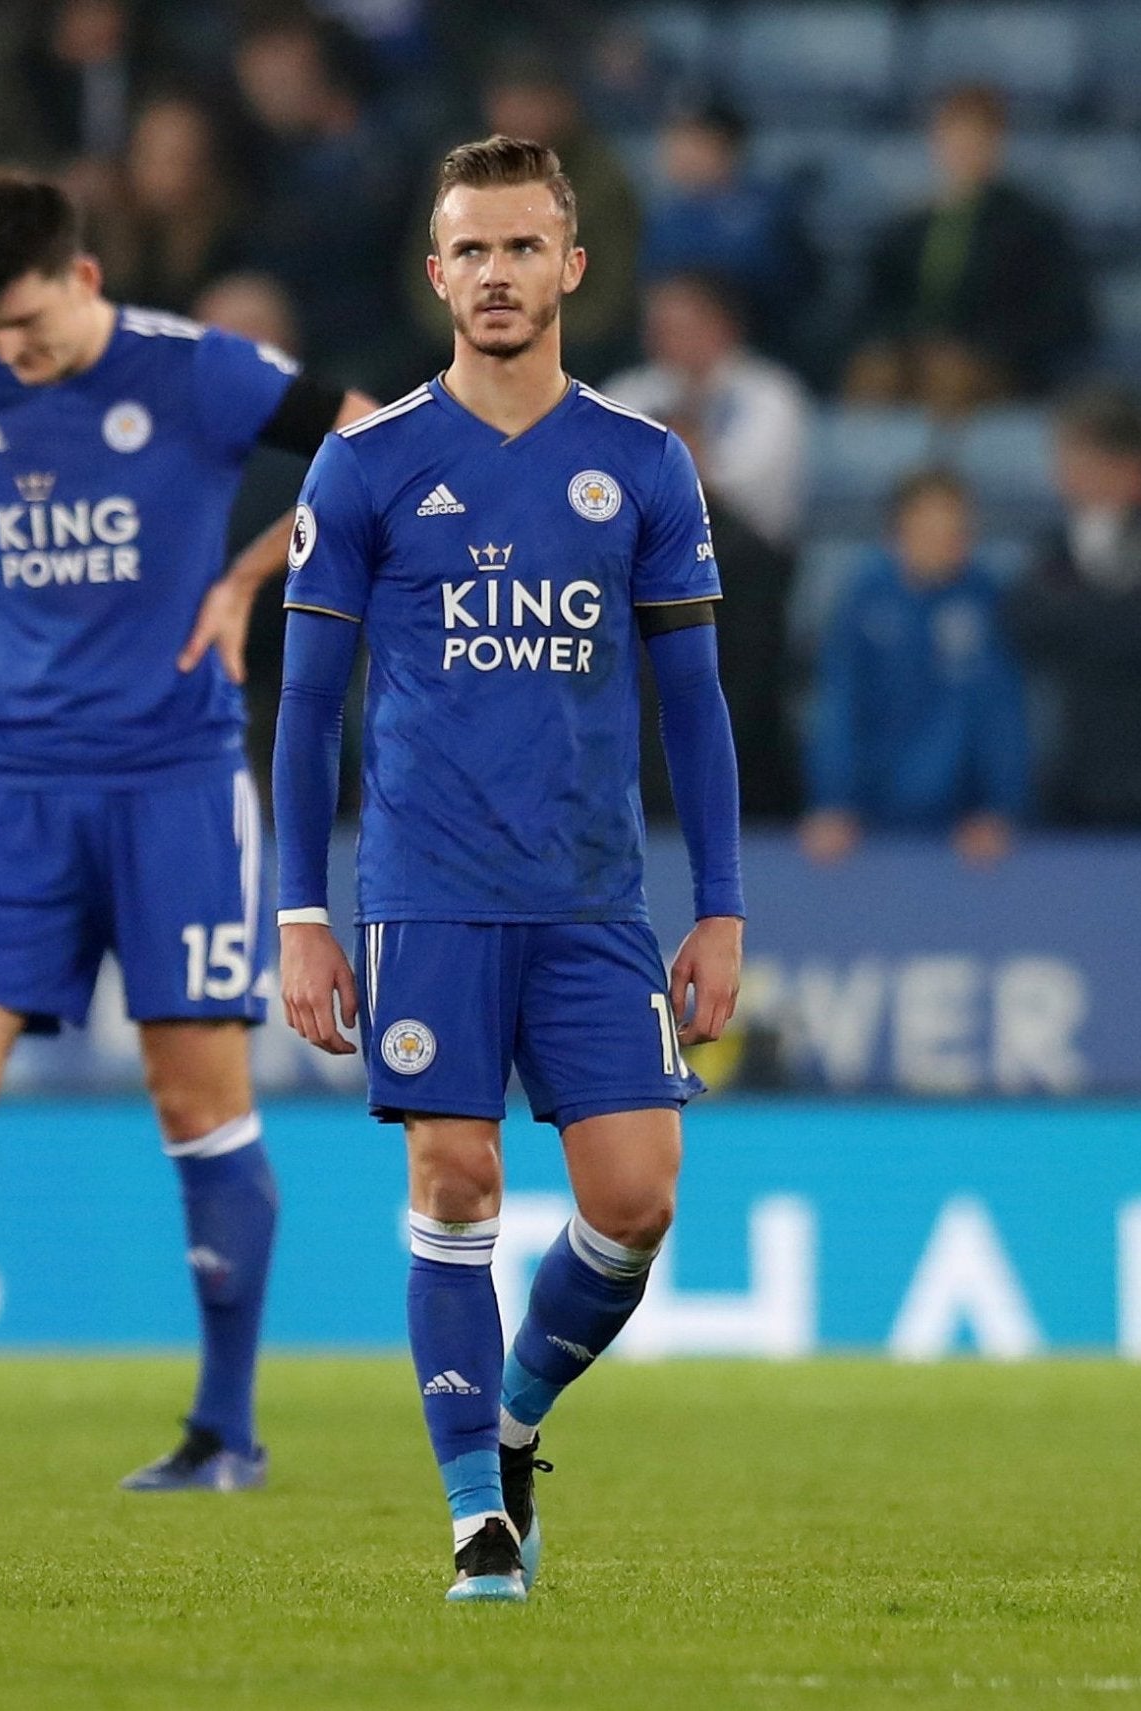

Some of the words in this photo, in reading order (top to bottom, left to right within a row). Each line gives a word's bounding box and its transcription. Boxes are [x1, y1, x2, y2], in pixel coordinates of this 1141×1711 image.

[416, 502, 466, 517] adidas
[1, 545, 141, 589] POWER
[441, 579, 603, 630] KING
[442, 634, 594, 674] POWER
[180, 922, 253, 1001] 15
